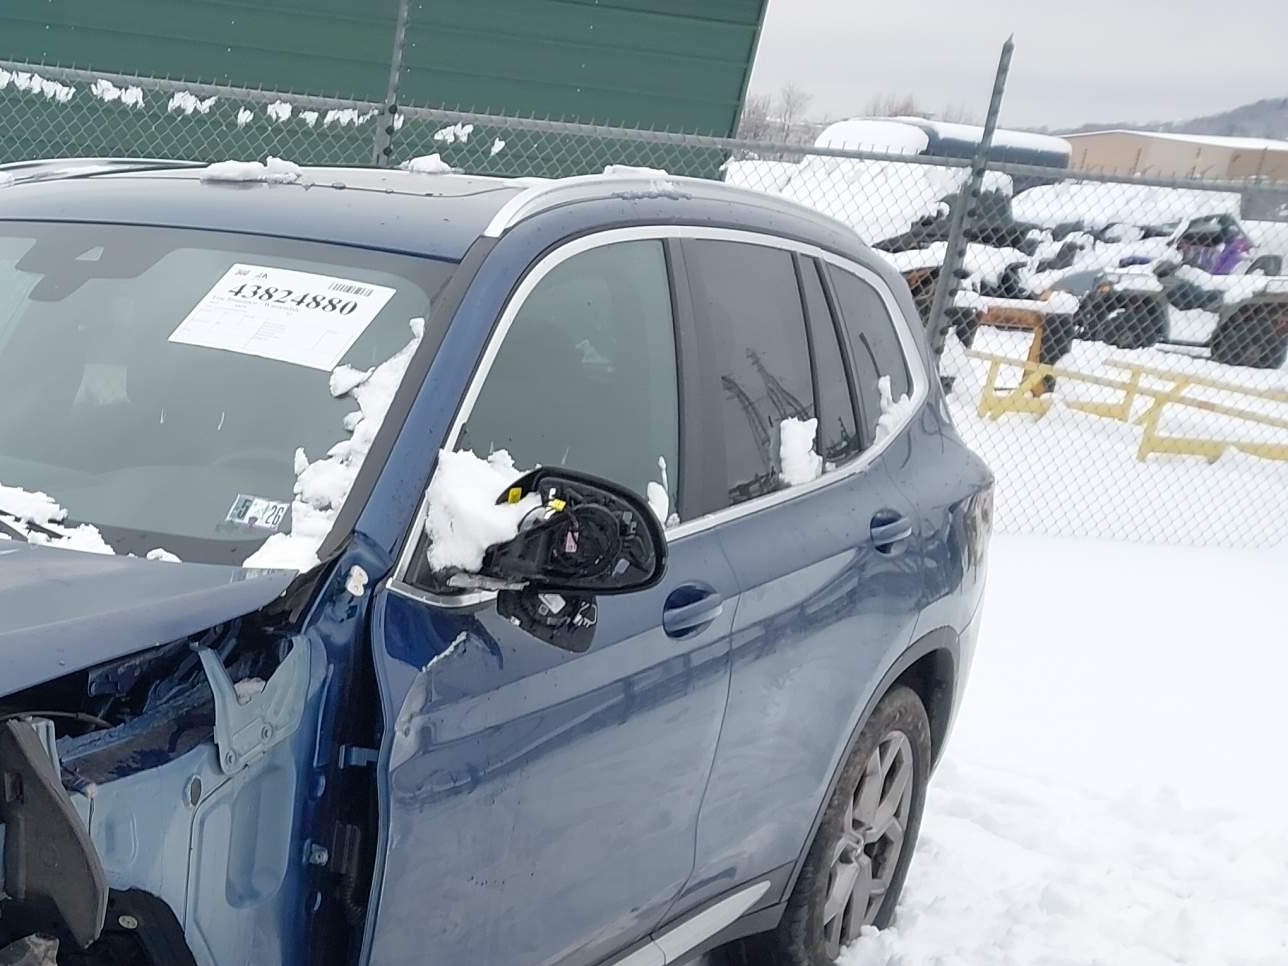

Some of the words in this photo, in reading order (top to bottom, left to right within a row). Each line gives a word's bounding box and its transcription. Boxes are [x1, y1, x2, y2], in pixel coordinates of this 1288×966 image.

[228, 283, 359, 316] 43824880
[237, 499, 252, 519] 5
[265, 505, 284, 525] 26
